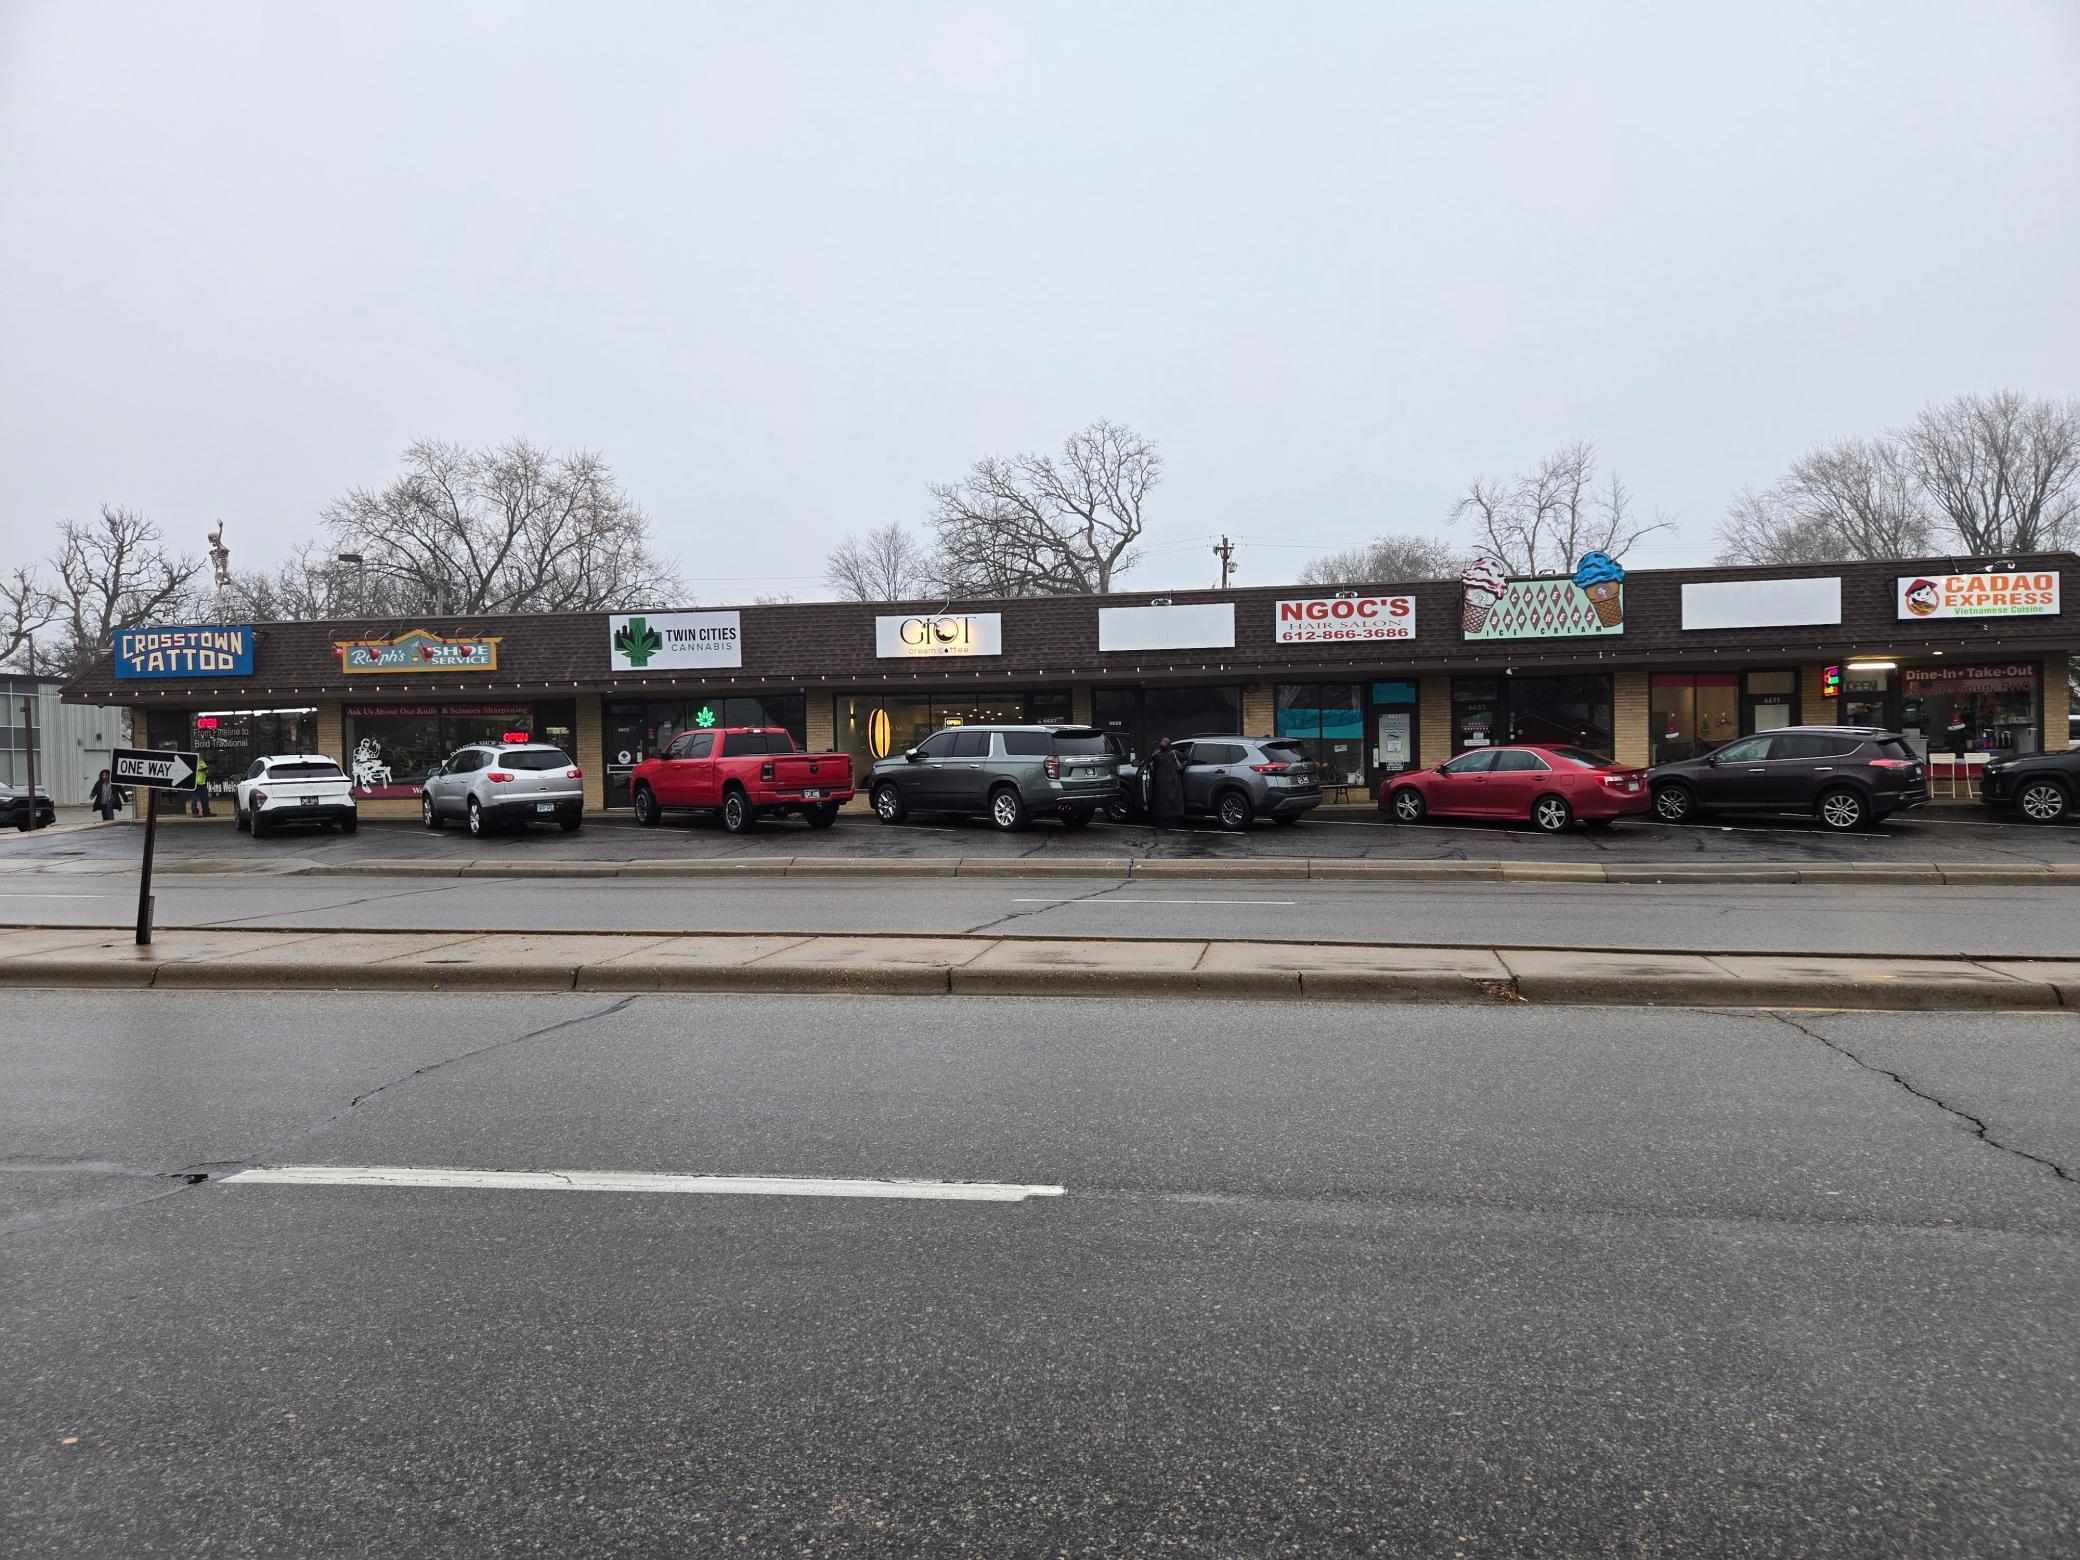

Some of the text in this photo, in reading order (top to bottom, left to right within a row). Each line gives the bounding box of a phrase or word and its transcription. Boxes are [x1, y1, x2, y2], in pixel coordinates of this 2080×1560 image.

[1944, 574, 2053, 593] CADAO
[1511, 594, 1558, 602] CONE
[1945, 592, 2053, 607] EXPRESS
[1281, 598, 1410, 621] NGOC'S
[1954, 605, 2044, 615] Vietnamese Cuisine
[1290, 619, 1401, 630] HAIR SALON
[1491, 611, 1594, 625] BROTHERS
[665, 627, 737, 642] TWIN CITIES
[900, 616, 977, 645] GIOT
[1282, 627, 1409, 641] 612-866-3686
[1486, 625, 1602, 637] ICE CREAM
[122, 631, 243, 660] CROSSTOWN
[671, 642, 732, 652] CANNABIS
[131, 648, 234, 672] TATTOO
[431, 656, 489, 665] SERVICE
[1906, 665, 2033, 680] Dine-In Take-Out
[375, 707, 398, 715] About
[400, 707, 414, 715] Our
[193, 729, 211, 737] From
[242, 728, 249, 736] to
[503, 732, 529, 743] OPEN
[194, 738, 248, 748] Bold Traditional
[121, 760, 172, 777] ONE WAY
